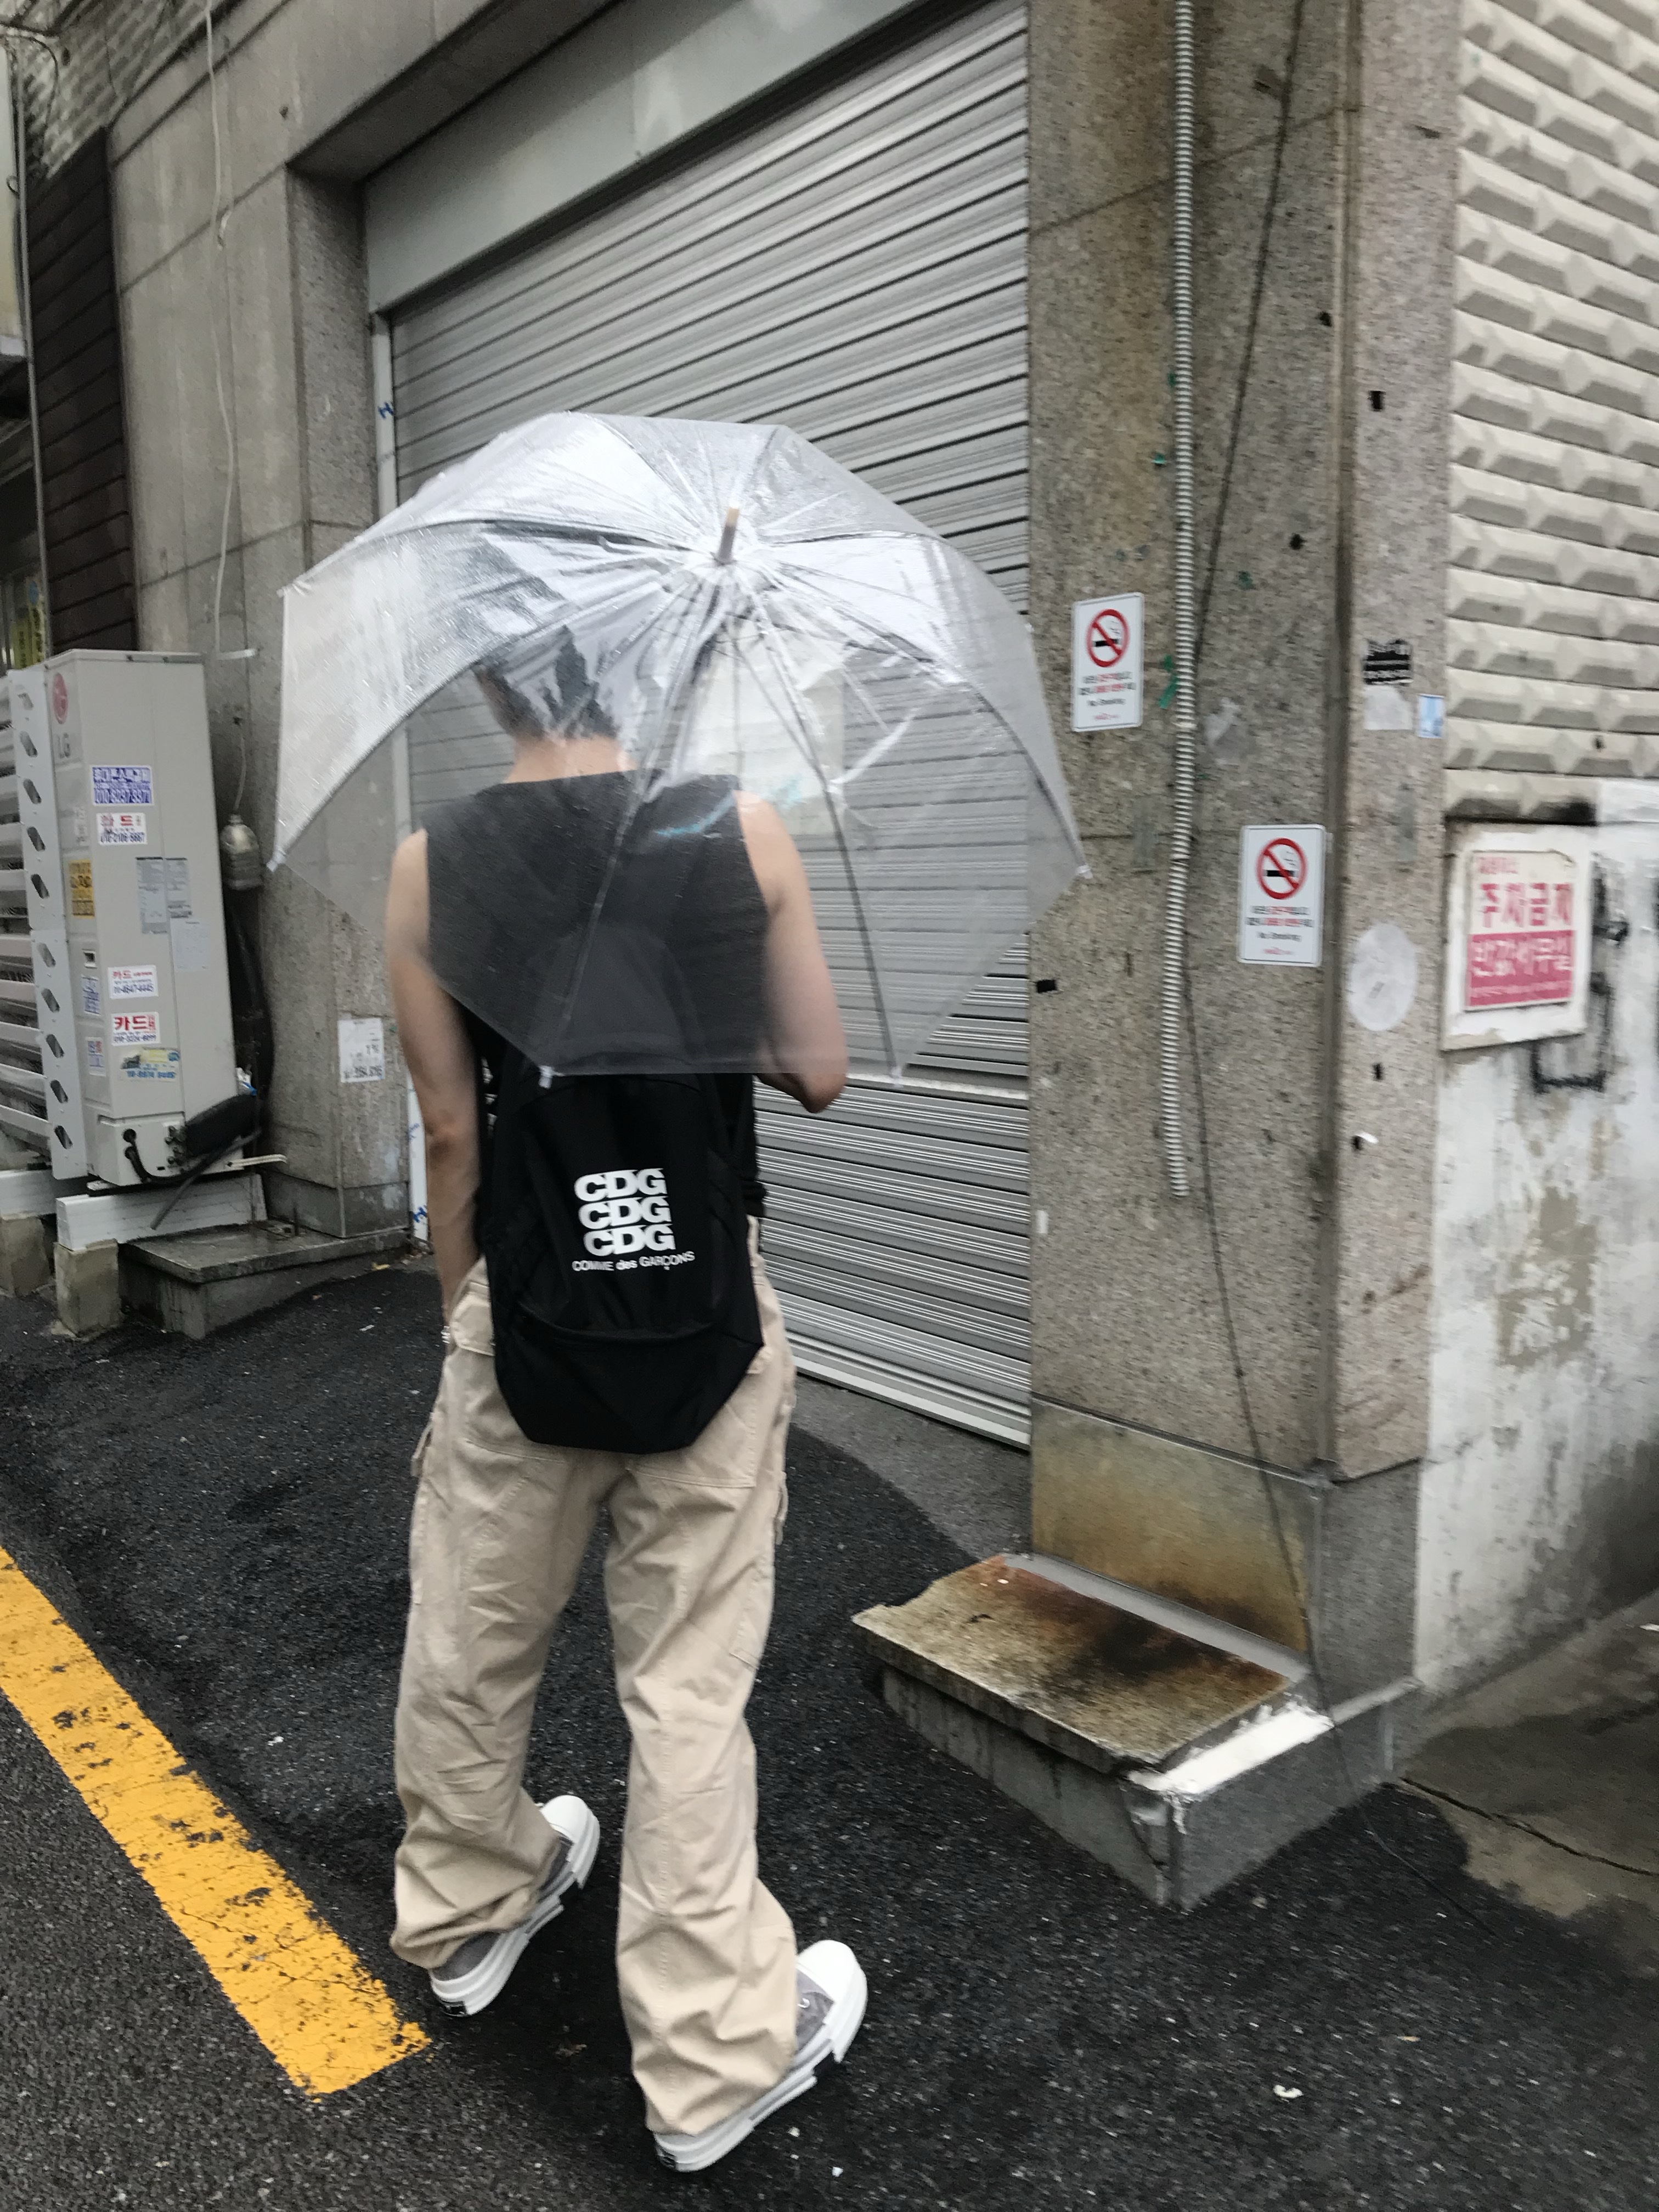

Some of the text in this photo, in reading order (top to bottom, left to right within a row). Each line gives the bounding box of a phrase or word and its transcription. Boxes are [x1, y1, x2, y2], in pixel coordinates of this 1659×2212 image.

[114, 1015, 146, 1031] 카드
[574, 1168, 667, 1201] CDG
[578, 1196, 672, 1229] CDG
[583, 1223, 676, 1256] CDG
[616, 1260, 637, 1270] des
[639, 1251, 695, 1270] GARÇONS
